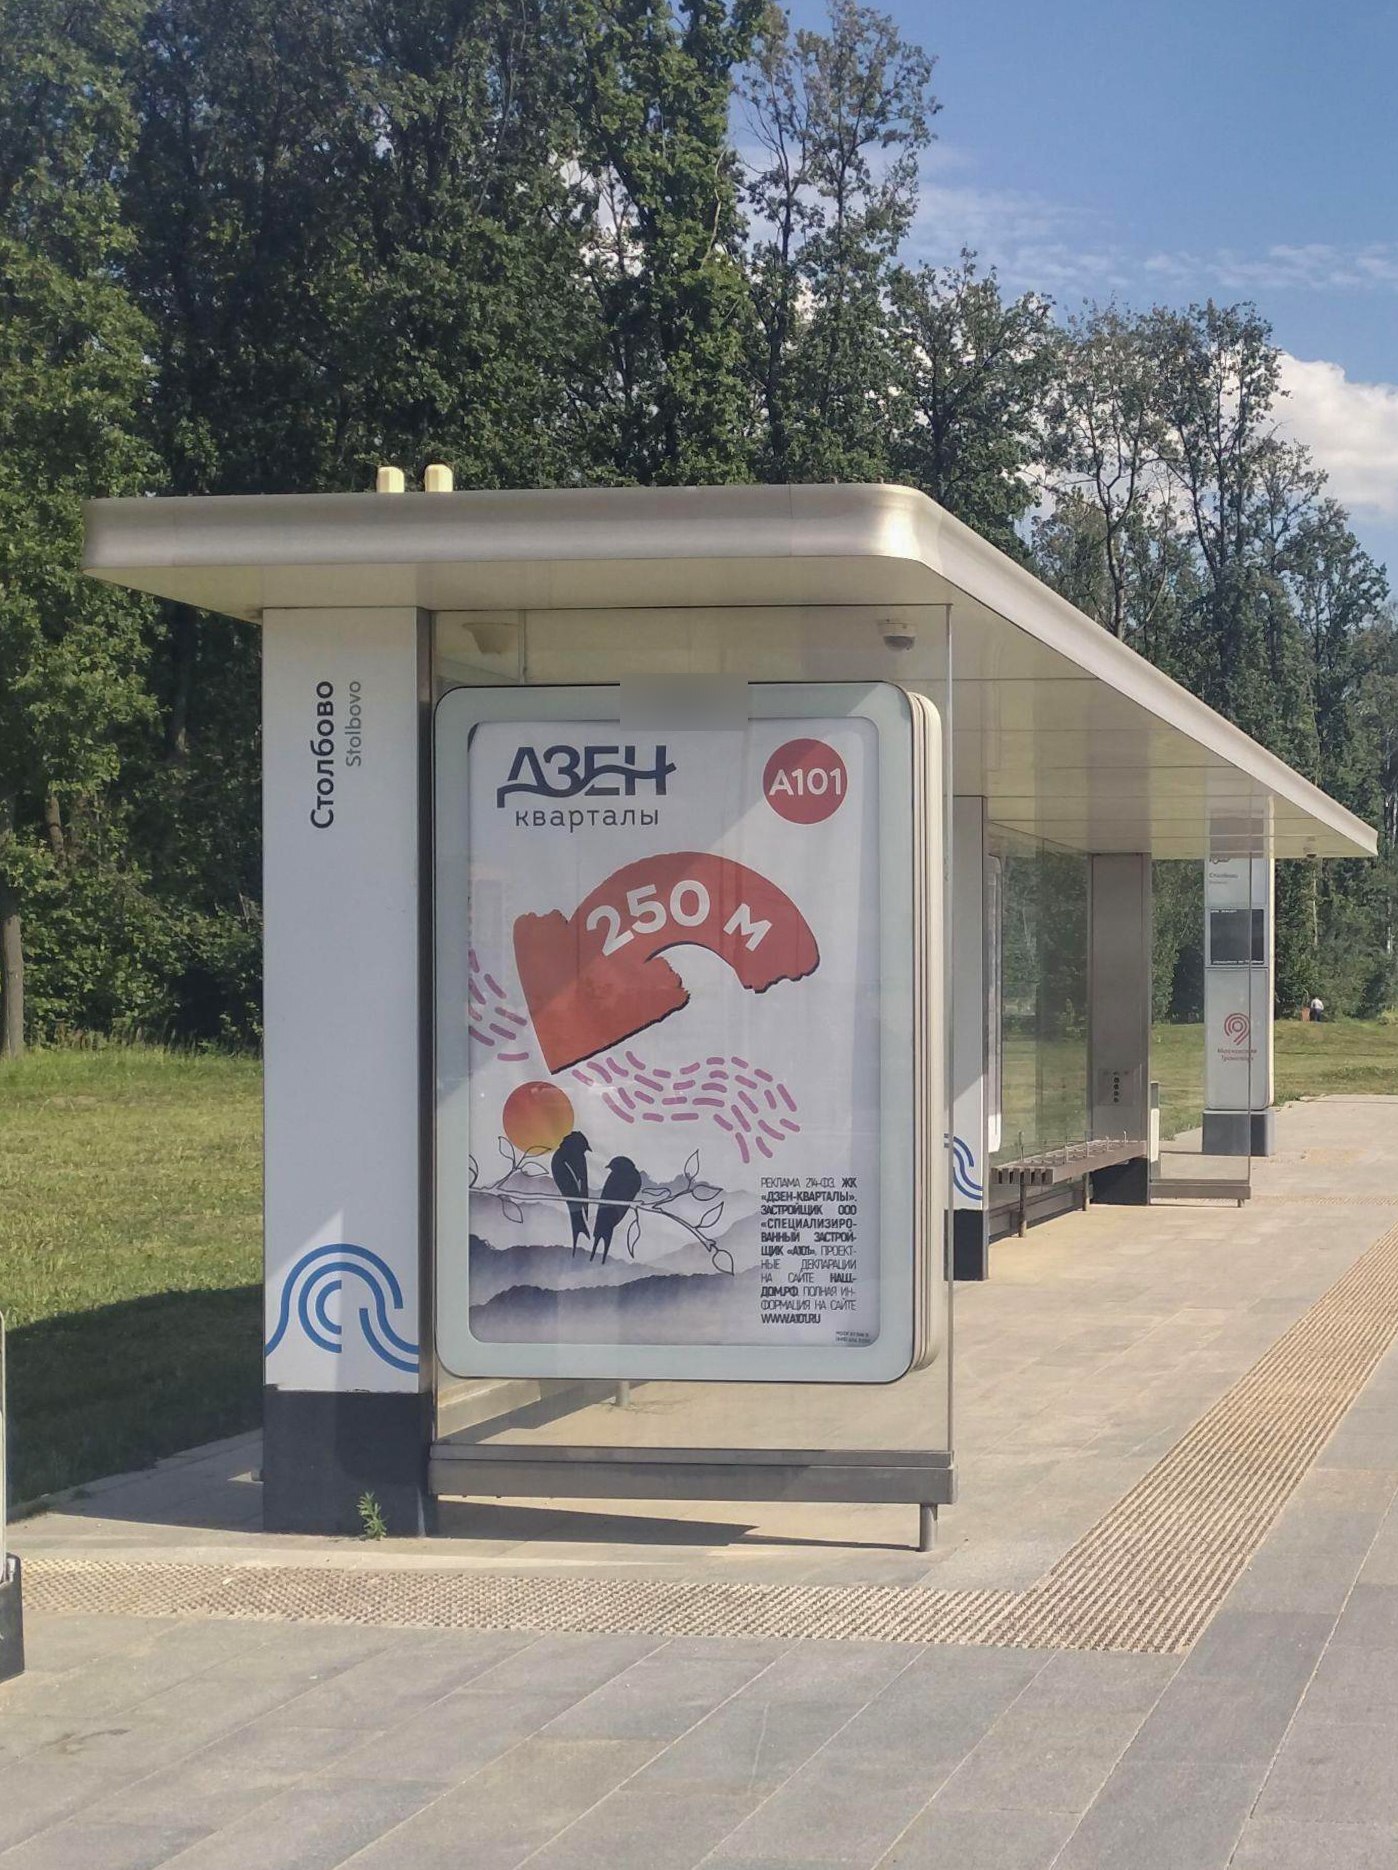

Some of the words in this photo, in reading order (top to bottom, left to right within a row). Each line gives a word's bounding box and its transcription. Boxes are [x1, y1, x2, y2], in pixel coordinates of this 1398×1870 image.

[345, 681, 362, 767] Stolbovo
[310, 681, 335, 829] Столбово
[496, 745, 677, 808] ДЗЕН
[768, 767, 843, 796] А101
[515, 807, 659, 833] кварталы
[586, 879, 711, 957] 250
[760, 1177, 801, 1188] РЕКЛАМА
[841, 1177, 858, 1188] ЖК
[760, 1203, 824, 1216] ЗАСТРОЙЩИК
[837, 1204, 858, 1215] ООО
[760, 1218, 858, 1230] «СПЕЦИАЛИЗИРО-
[760, 1231, 801, 1242] ВАННЫЙ
[813, 1230, 858, 1242] ЗАСТРОЙ-
[760, 1245, 784, 1257] ЩИК
[820, 1245, 857, 1256] ПРОЕКТ-
[760, 1259, 781, 1269] НЫЕ
[800, 1259, 857, 1271] ДЕКЛАРАЦИИ
[760, 1272, 773, 1283] НА
[787, 1271, 815, 1283] САЙТЕ
[803, 1286, 838, 1297] ПОЛНАЯ
[840, 1286, 856, 1297] ИН-
[760, 1300, 811, 1311] ФОРМАЦИЯ
[814, 1300, 827, 1310] НА
[830, 1298, 857, 1311] САЙТЕ
